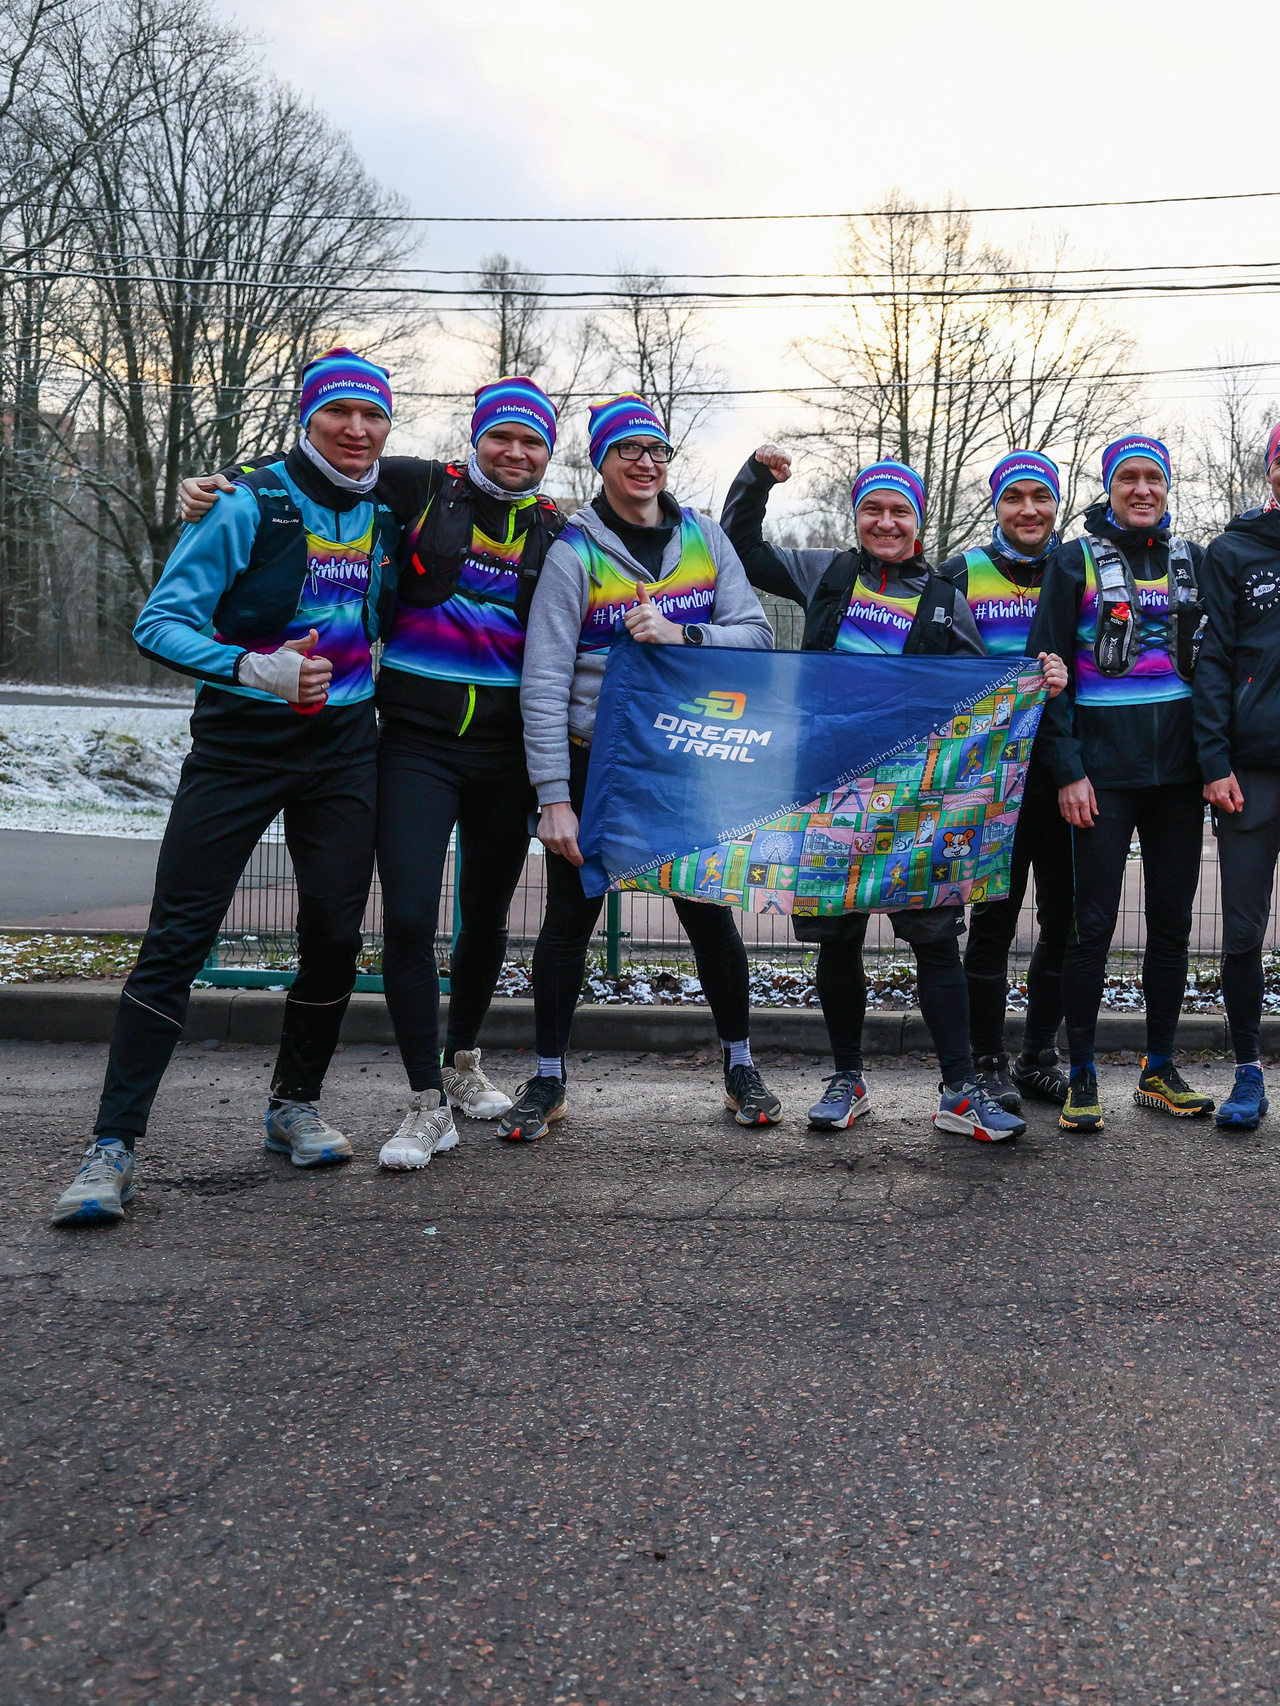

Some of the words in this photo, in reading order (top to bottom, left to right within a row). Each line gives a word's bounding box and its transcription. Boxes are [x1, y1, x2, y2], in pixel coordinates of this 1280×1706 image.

[318, 380, 380, 396] #khimkirunbar
[496, 405, 549, 430] #khimkirunbar
[653, 712, 773, 747] DREAM
[665, 734, 756, 763] TRAIL
[836, 734, 918, 786] #khimkirunbar
[716, 800, 801, 843] #khimkirunbar
